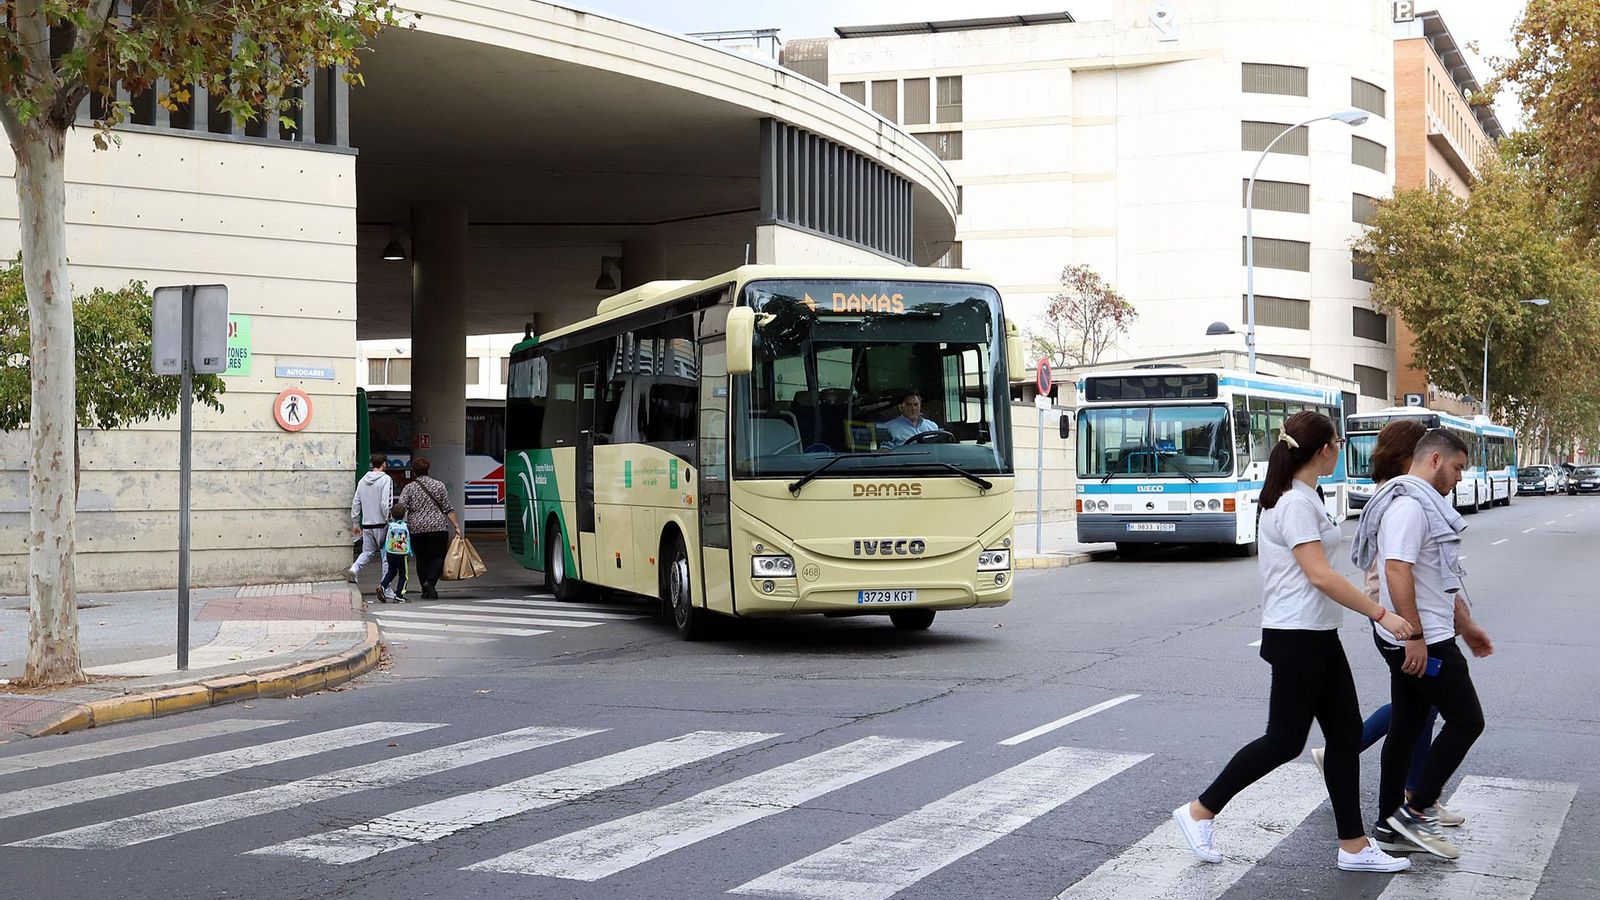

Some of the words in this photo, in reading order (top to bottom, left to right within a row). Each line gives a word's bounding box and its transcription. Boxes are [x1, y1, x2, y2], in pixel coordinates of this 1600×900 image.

[832, 292, 905, 313] DAMAS
[853, 483, 922, 497] DAMAS
[1137, 485, 1164, 493] IVECO
[853, 539, 926, 556] IVECO
[803, 567, 819, 577] 468
[864, 591, 891, 602] 3729
[893, 591, 914, 602] KGT
